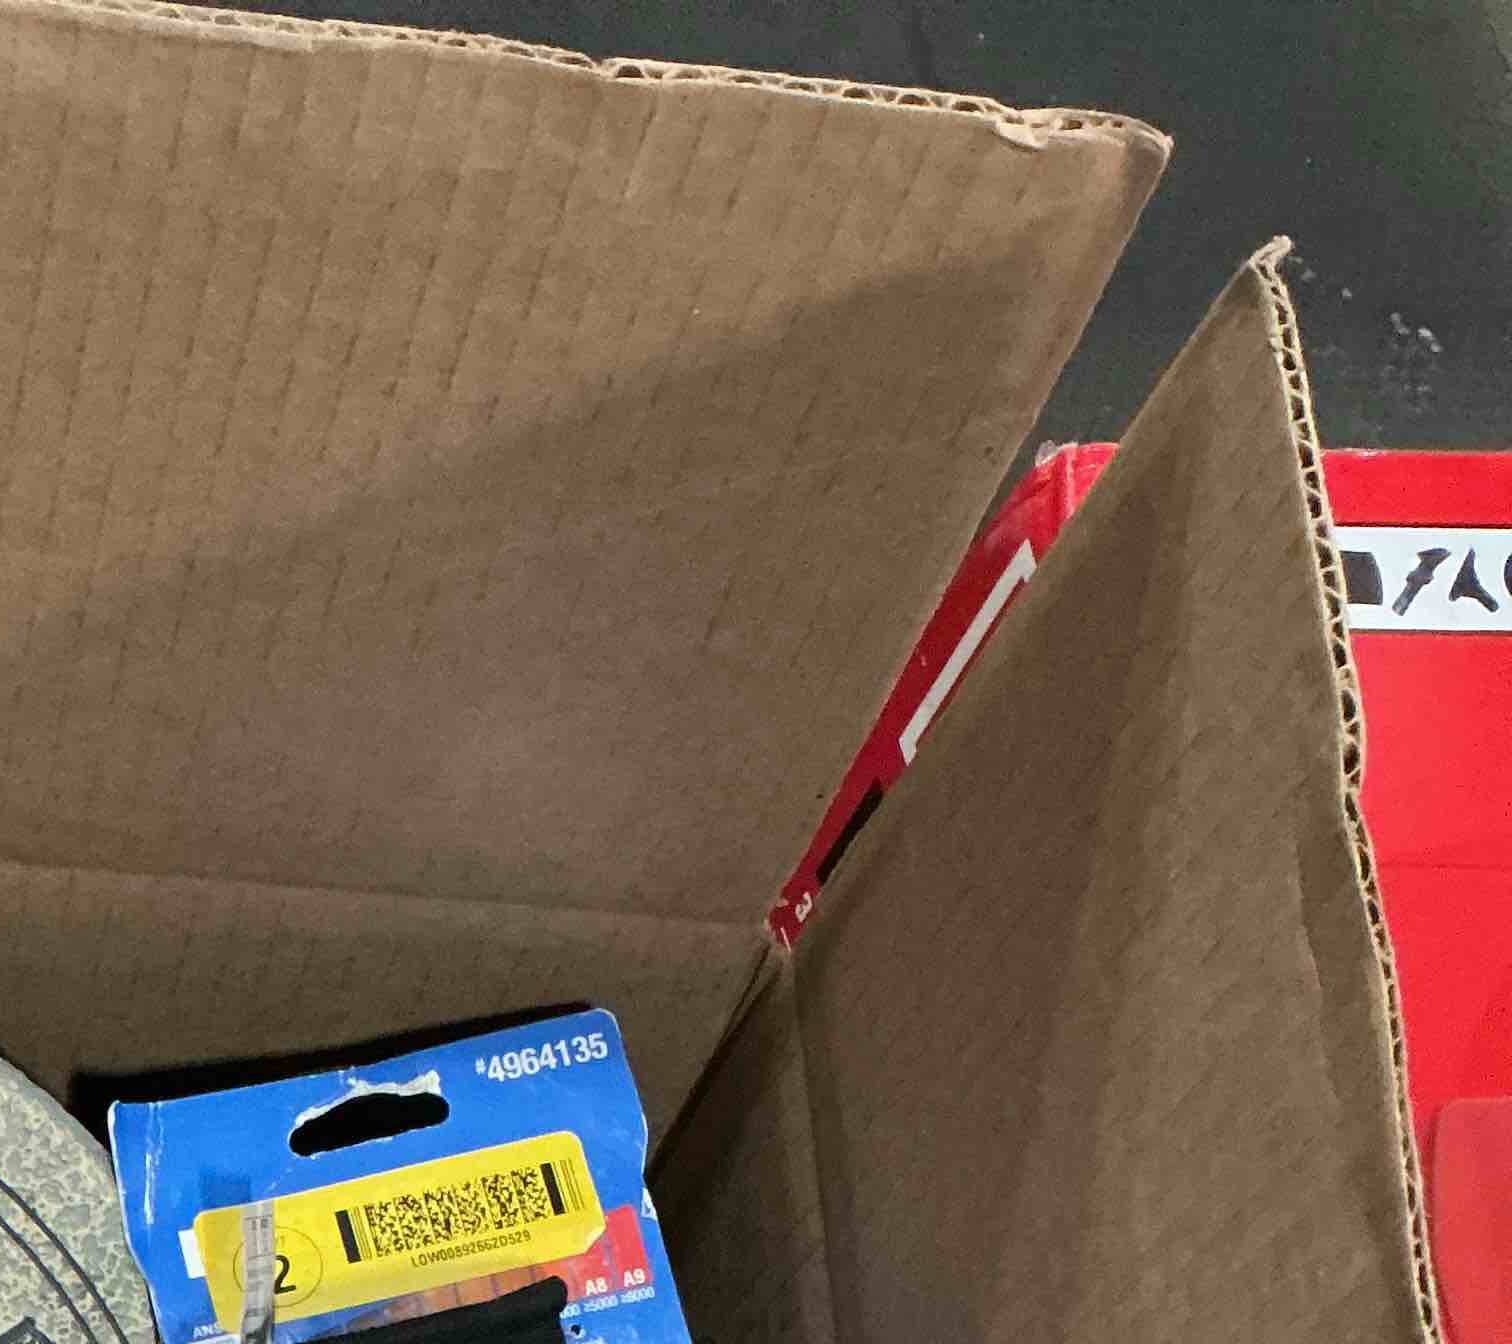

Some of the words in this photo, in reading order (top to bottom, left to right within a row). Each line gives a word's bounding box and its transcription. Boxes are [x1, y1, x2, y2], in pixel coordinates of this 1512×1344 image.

[475, 1031, 608, 1084] #4964135
[273, 1253, 296, 1294] 2
[585, 1276, 608, 1295] A8
[622, 1268, 645, 1287] A9
